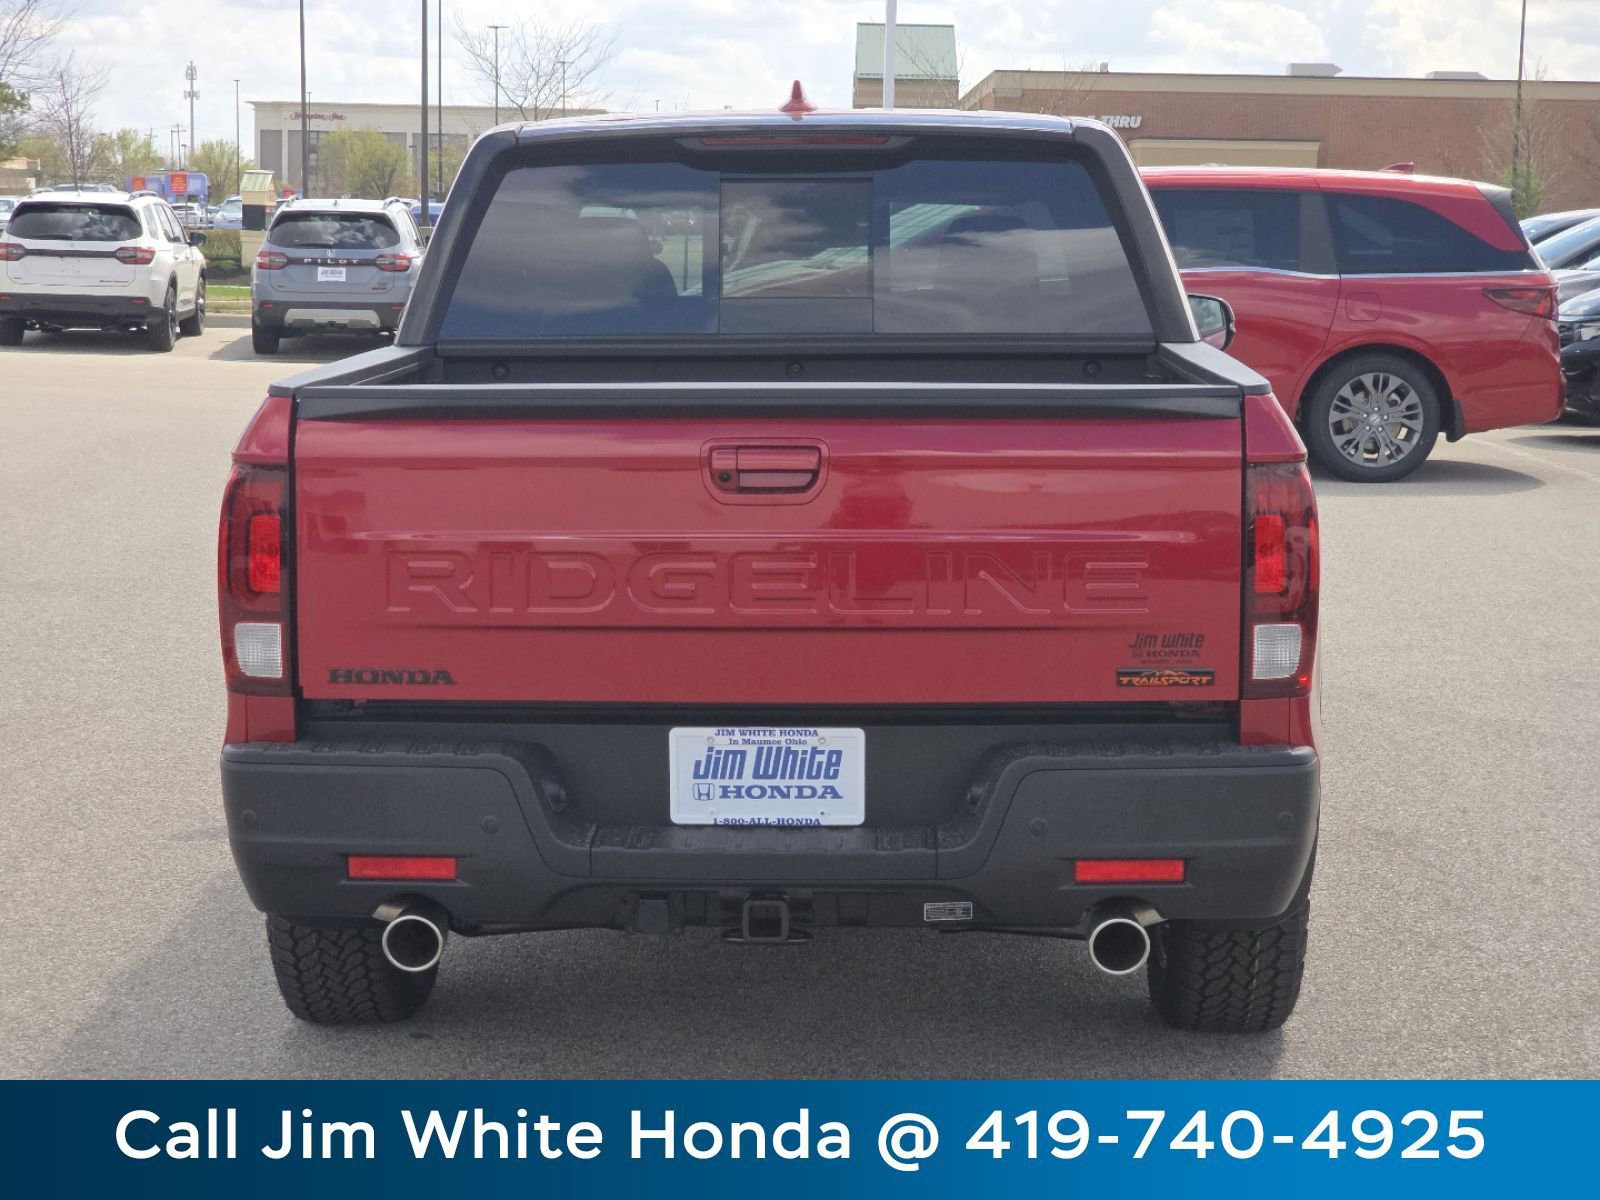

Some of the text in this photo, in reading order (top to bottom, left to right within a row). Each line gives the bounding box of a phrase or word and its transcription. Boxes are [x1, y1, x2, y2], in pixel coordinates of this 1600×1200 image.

[386, 551, 1149, 615] RIDGELINE
[1146, 650, 1201, 658] HONDA
[327, 668, 457, 685] HONDA
[1119, 676, 1212, 686] TRAILSPORT
[714, 729, 819, 737] JIM WHITE HONDA
[752, 746, 843, 780] White
[719, 785, 843, 800] HONDA
[713, 817, 821, 826] 1-800-ALL-HONDA
